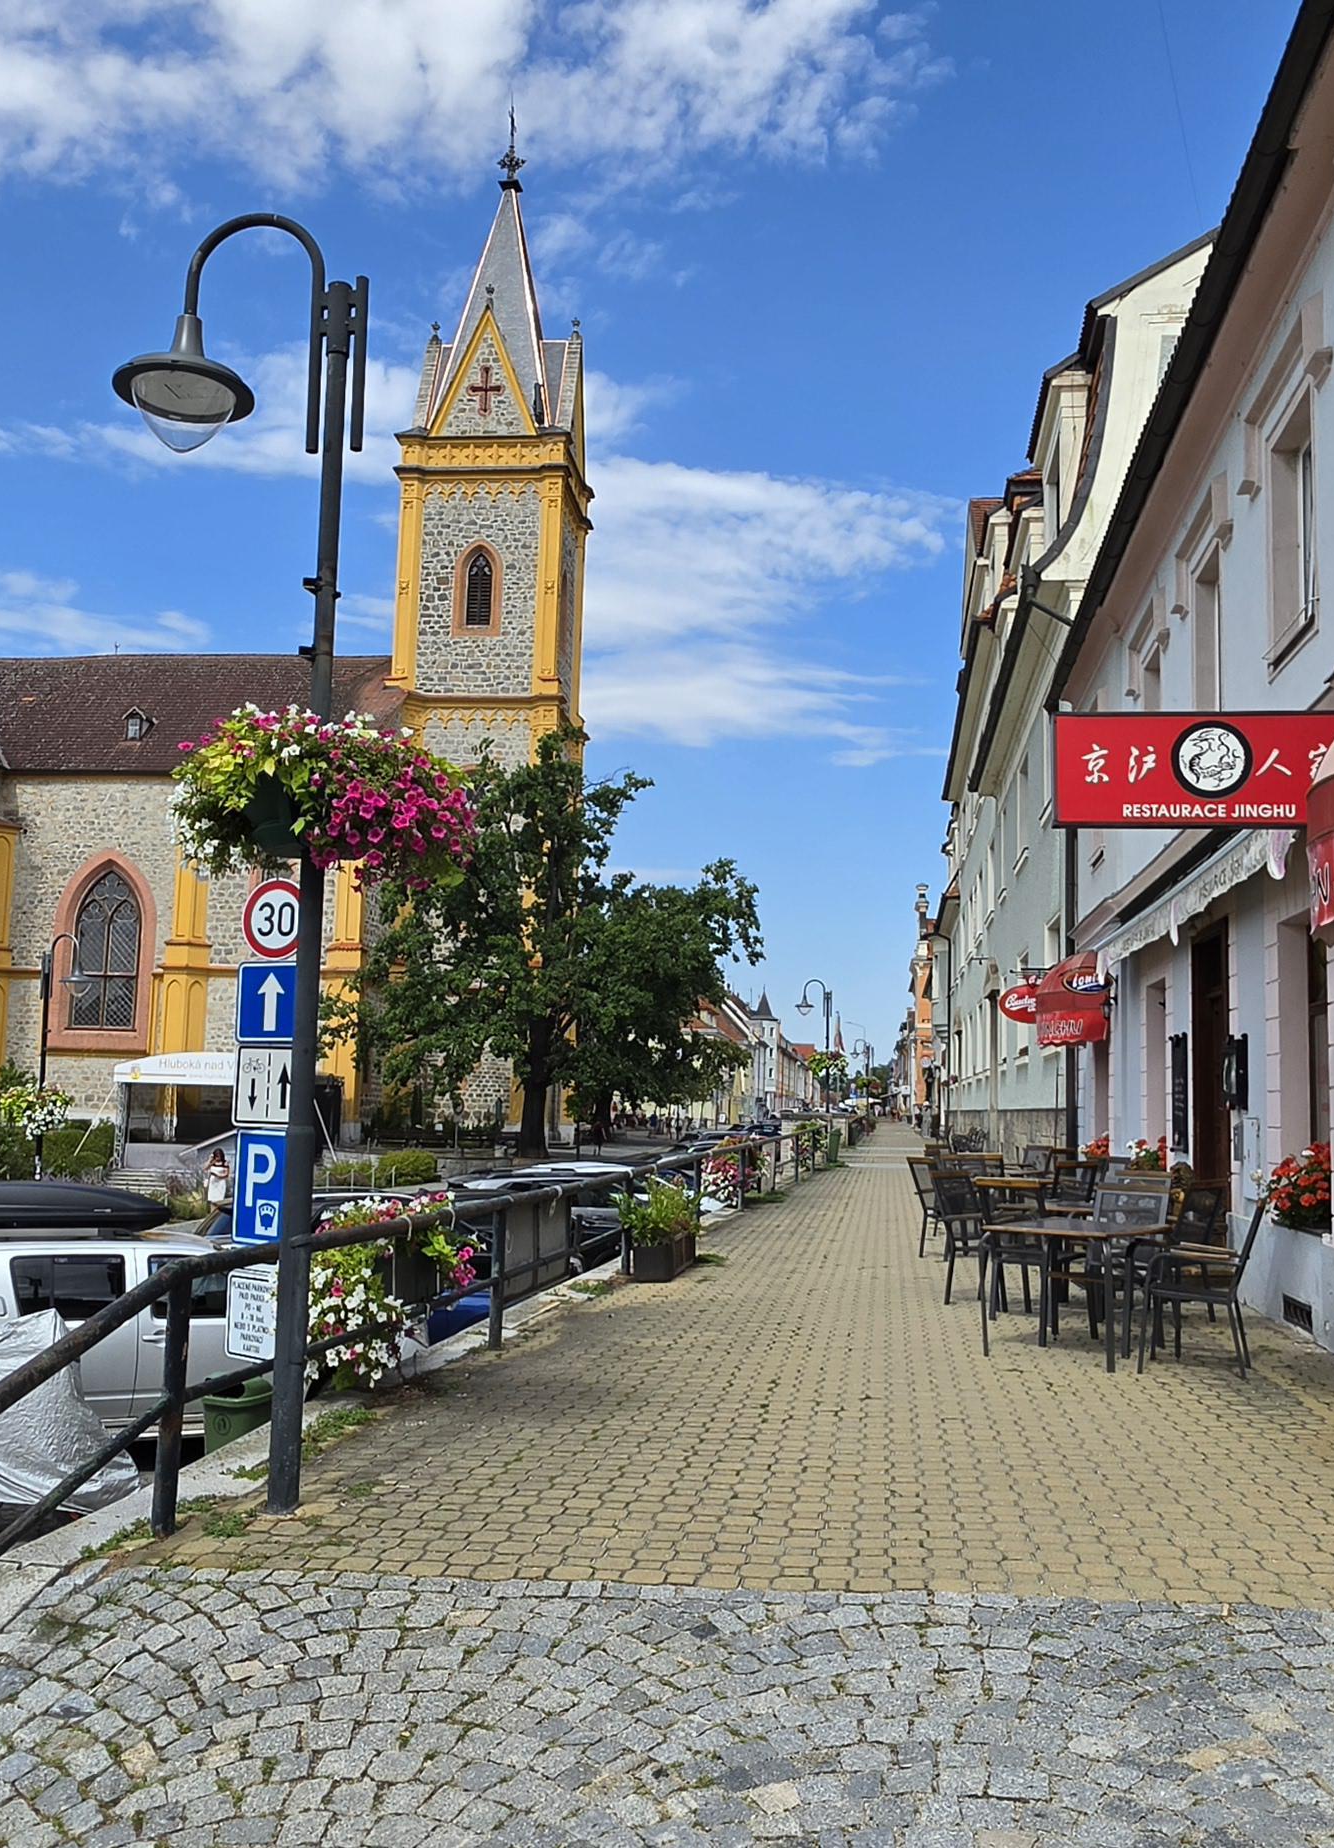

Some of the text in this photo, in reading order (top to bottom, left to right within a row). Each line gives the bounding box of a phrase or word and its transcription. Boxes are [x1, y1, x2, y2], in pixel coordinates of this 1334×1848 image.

[1122, 803, 1297, 819] RESTAURACE JINGHU
[257, 901, 296, 937] 30
[245, 1143, 277, 1208] P
